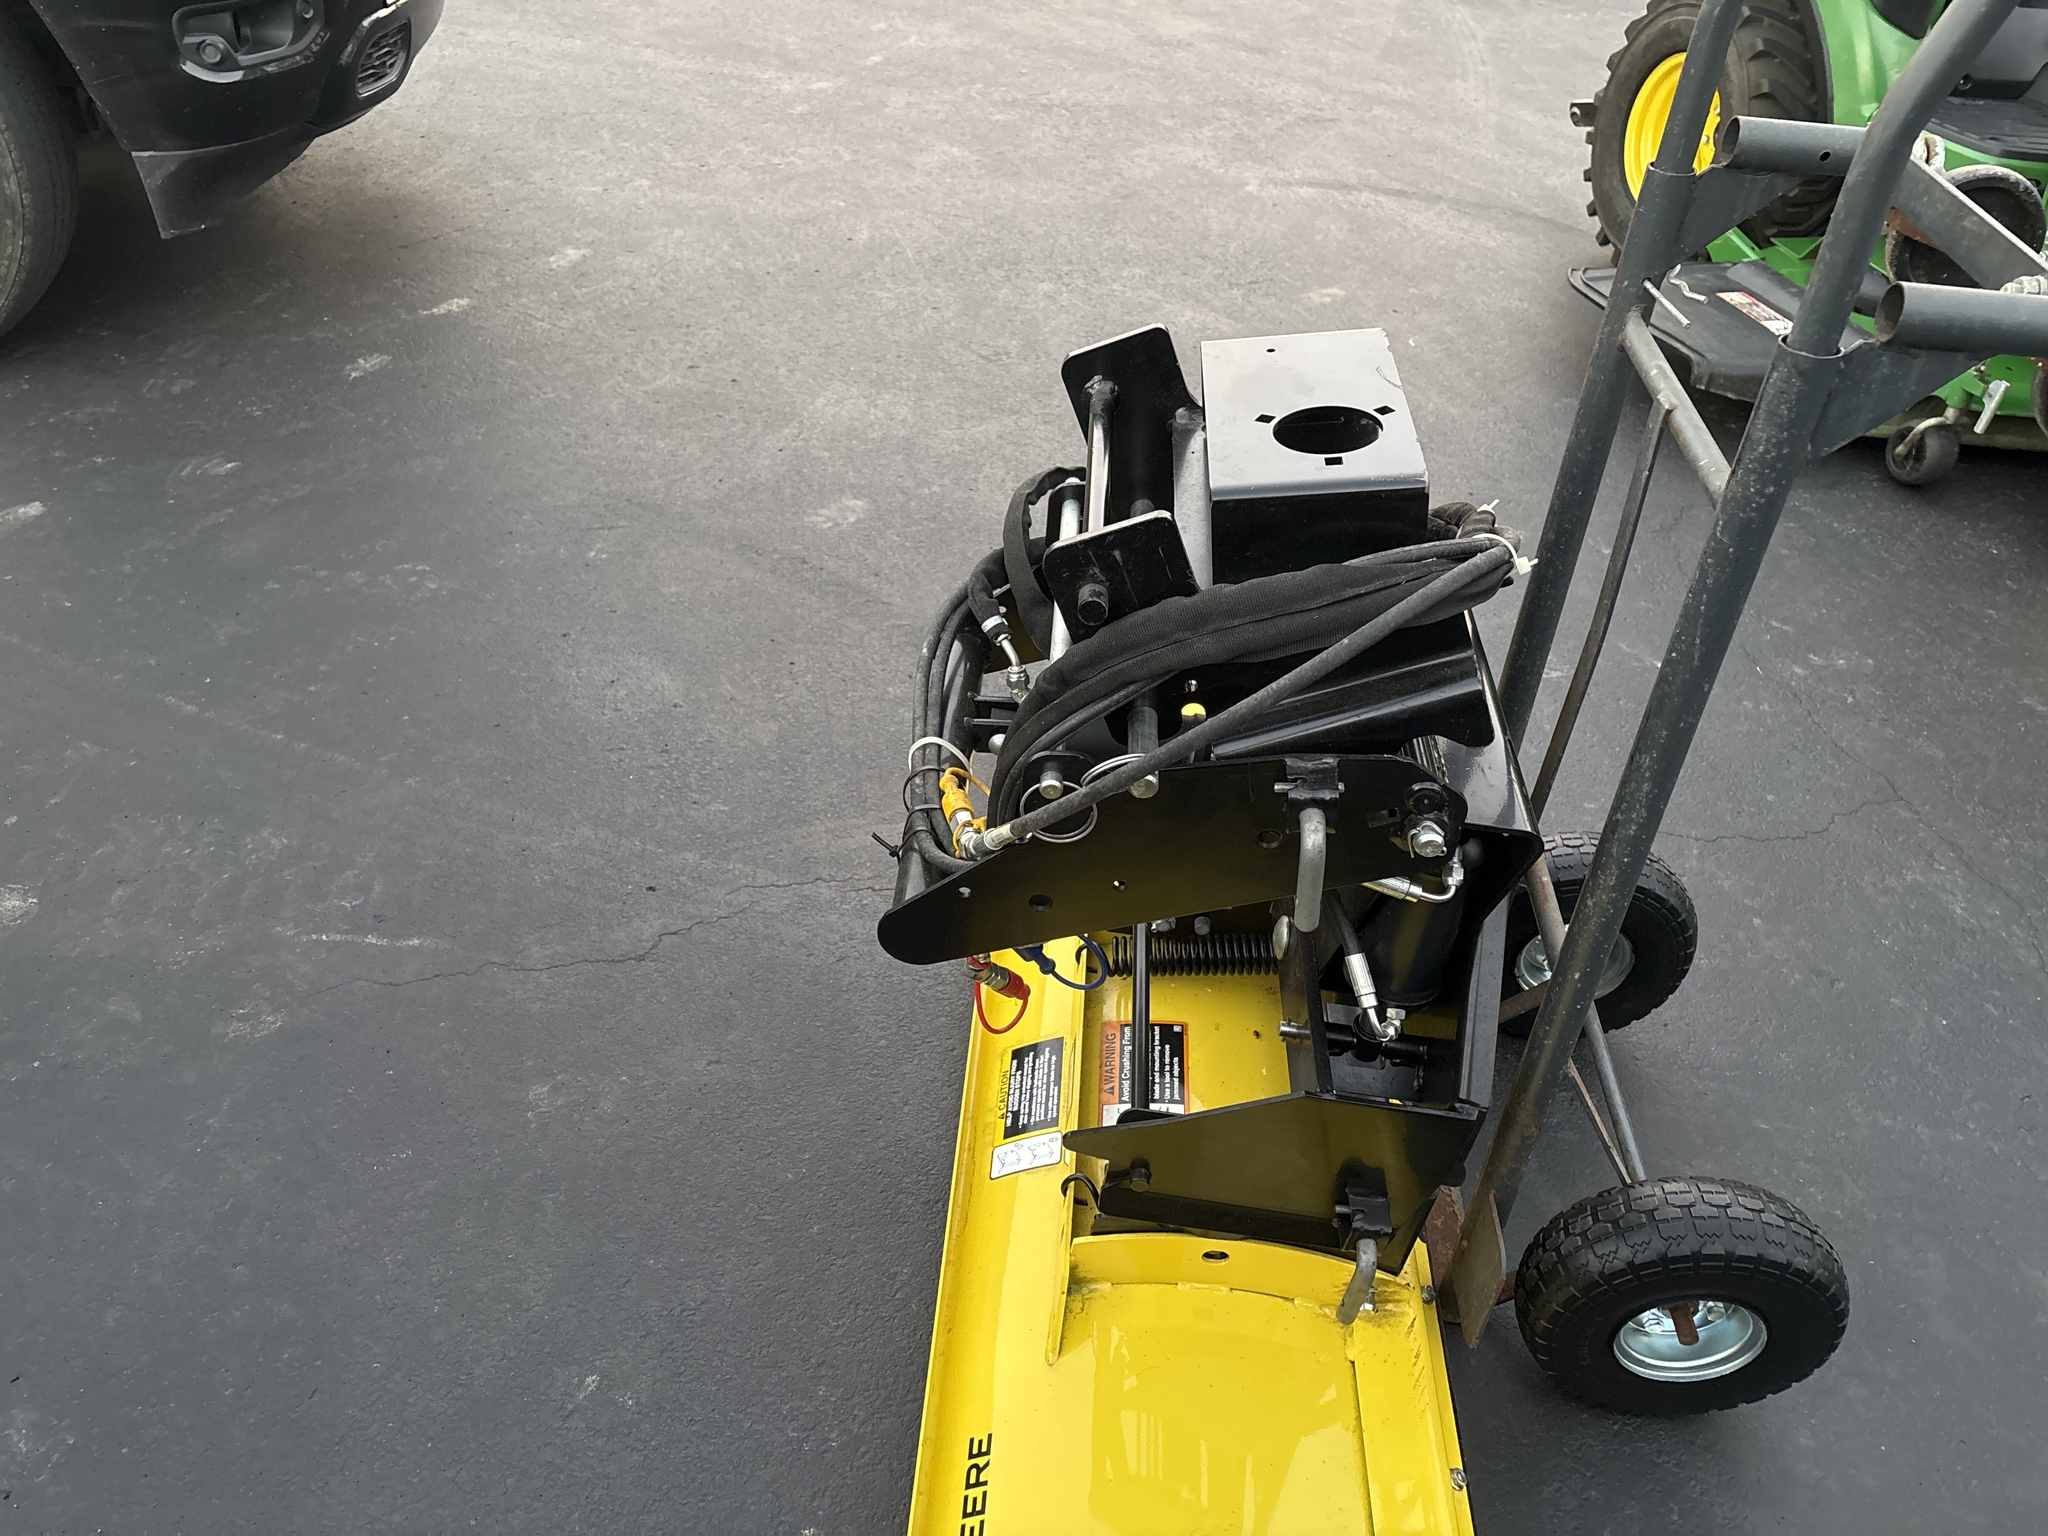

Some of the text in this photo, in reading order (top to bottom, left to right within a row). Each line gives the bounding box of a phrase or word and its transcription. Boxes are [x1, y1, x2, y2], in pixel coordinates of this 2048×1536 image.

[1105, 1033, 1116, 1085] WARNING
[1121, 1027, 1132, 1102] Avoid Crushing From
[1153, 1046, 1161, 1071] mounting
[998, 1070, 1009, 1111] CAUTION
[1172, 1078, 1181, 1100] jammed
